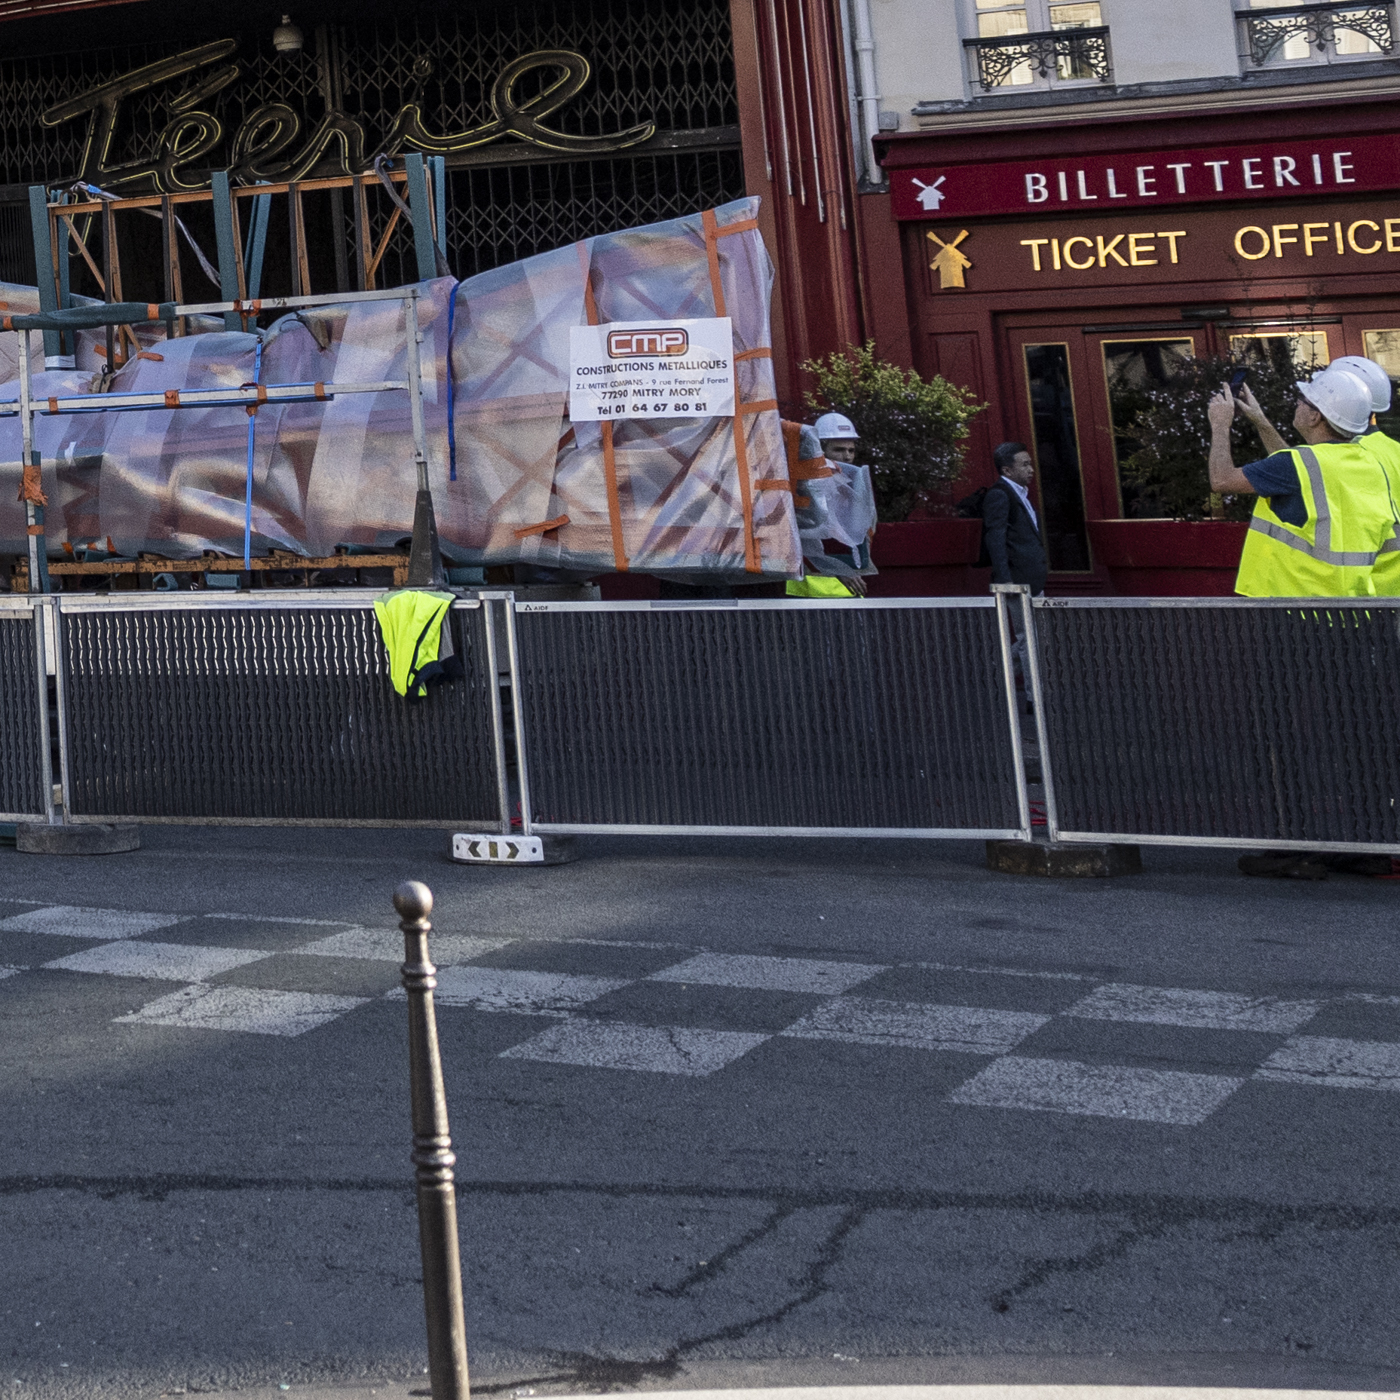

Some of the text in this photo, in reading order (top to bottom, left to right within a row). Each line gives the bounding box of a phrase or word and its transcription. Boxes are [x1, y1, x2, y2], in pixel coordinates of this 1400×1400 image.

[1025, 152, 1355, 203] BILLETTERIE
[1020, 218, 1400, 271] TICKET OFFICE
[611, 333, 683, 353] CMP
[576, 359, 728, 376] CONSTRUCTIONS METALLIQUES
[588, 381, 608, 389] MITRY
[610, 379, 644, 388] COMPANS
[674, 377, 705, 385] Fernand
[707, 376, 729, 384] Forest
[601, 387, 702, 400] 77290 MITRY MORY
[597, 402, 708, 415] Tél 01 64 67 80 81
